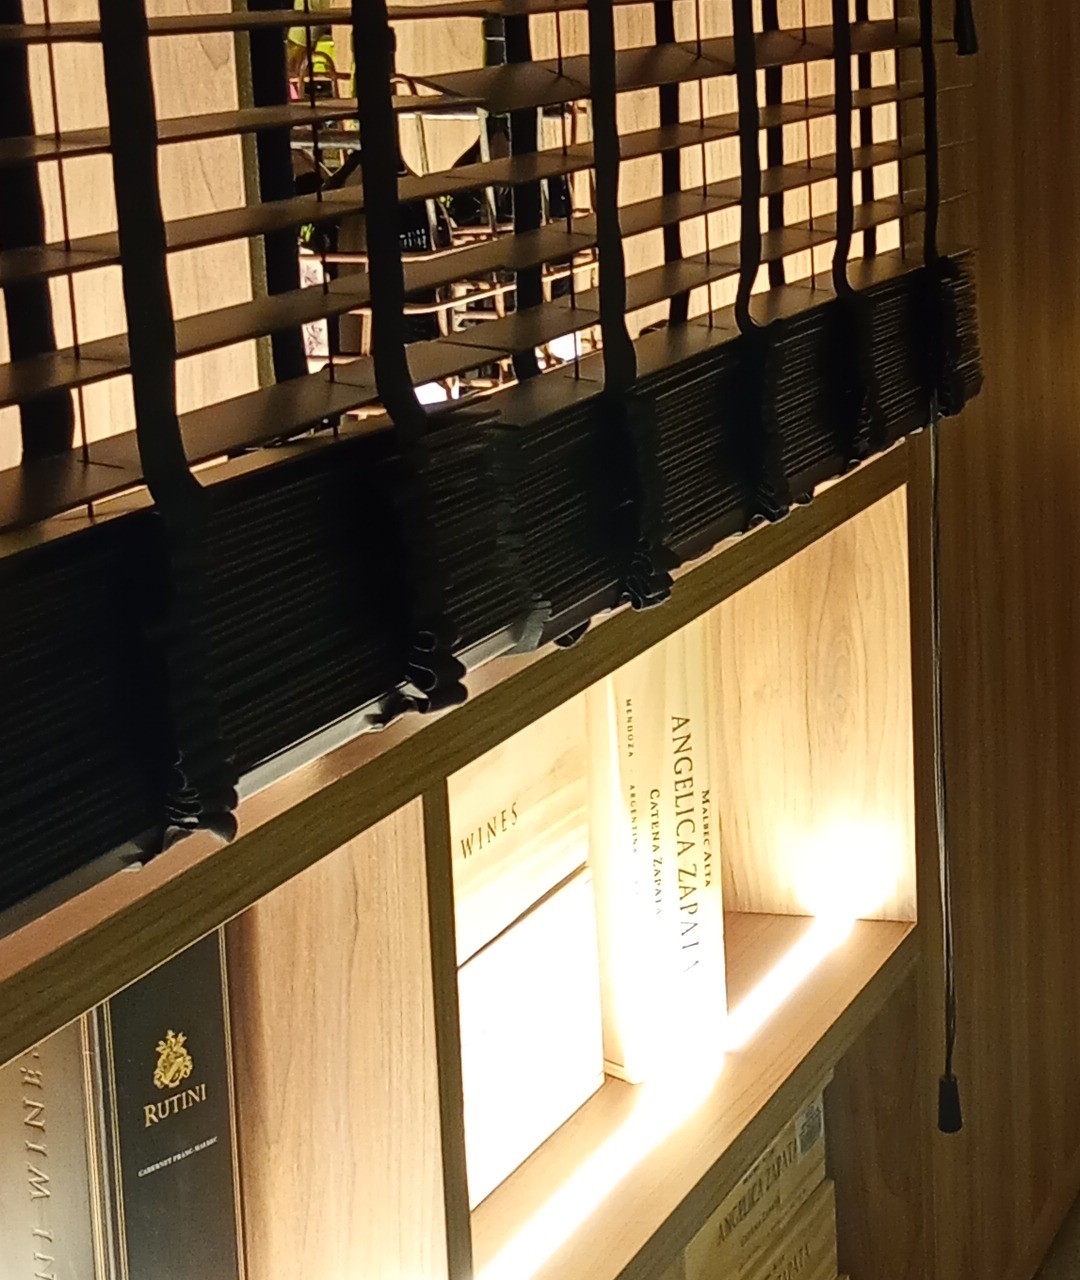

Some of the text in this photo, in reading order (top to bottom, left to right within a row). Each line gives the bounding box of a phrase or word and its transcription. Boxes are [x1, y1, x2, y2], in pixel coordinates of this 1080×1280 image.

[626, 697, 635, 759] MENDOZA
[671, 715, 697, 858] ANGELICA
[459, 801, 519, 860] WINES
[650, 787, 661, 854] CATENA
[702, 788, 712, 888] MALBEC ALTA
[19, 1052, 51, 1202] WINE
[143, 1082, 207, 1128] RUTINI
